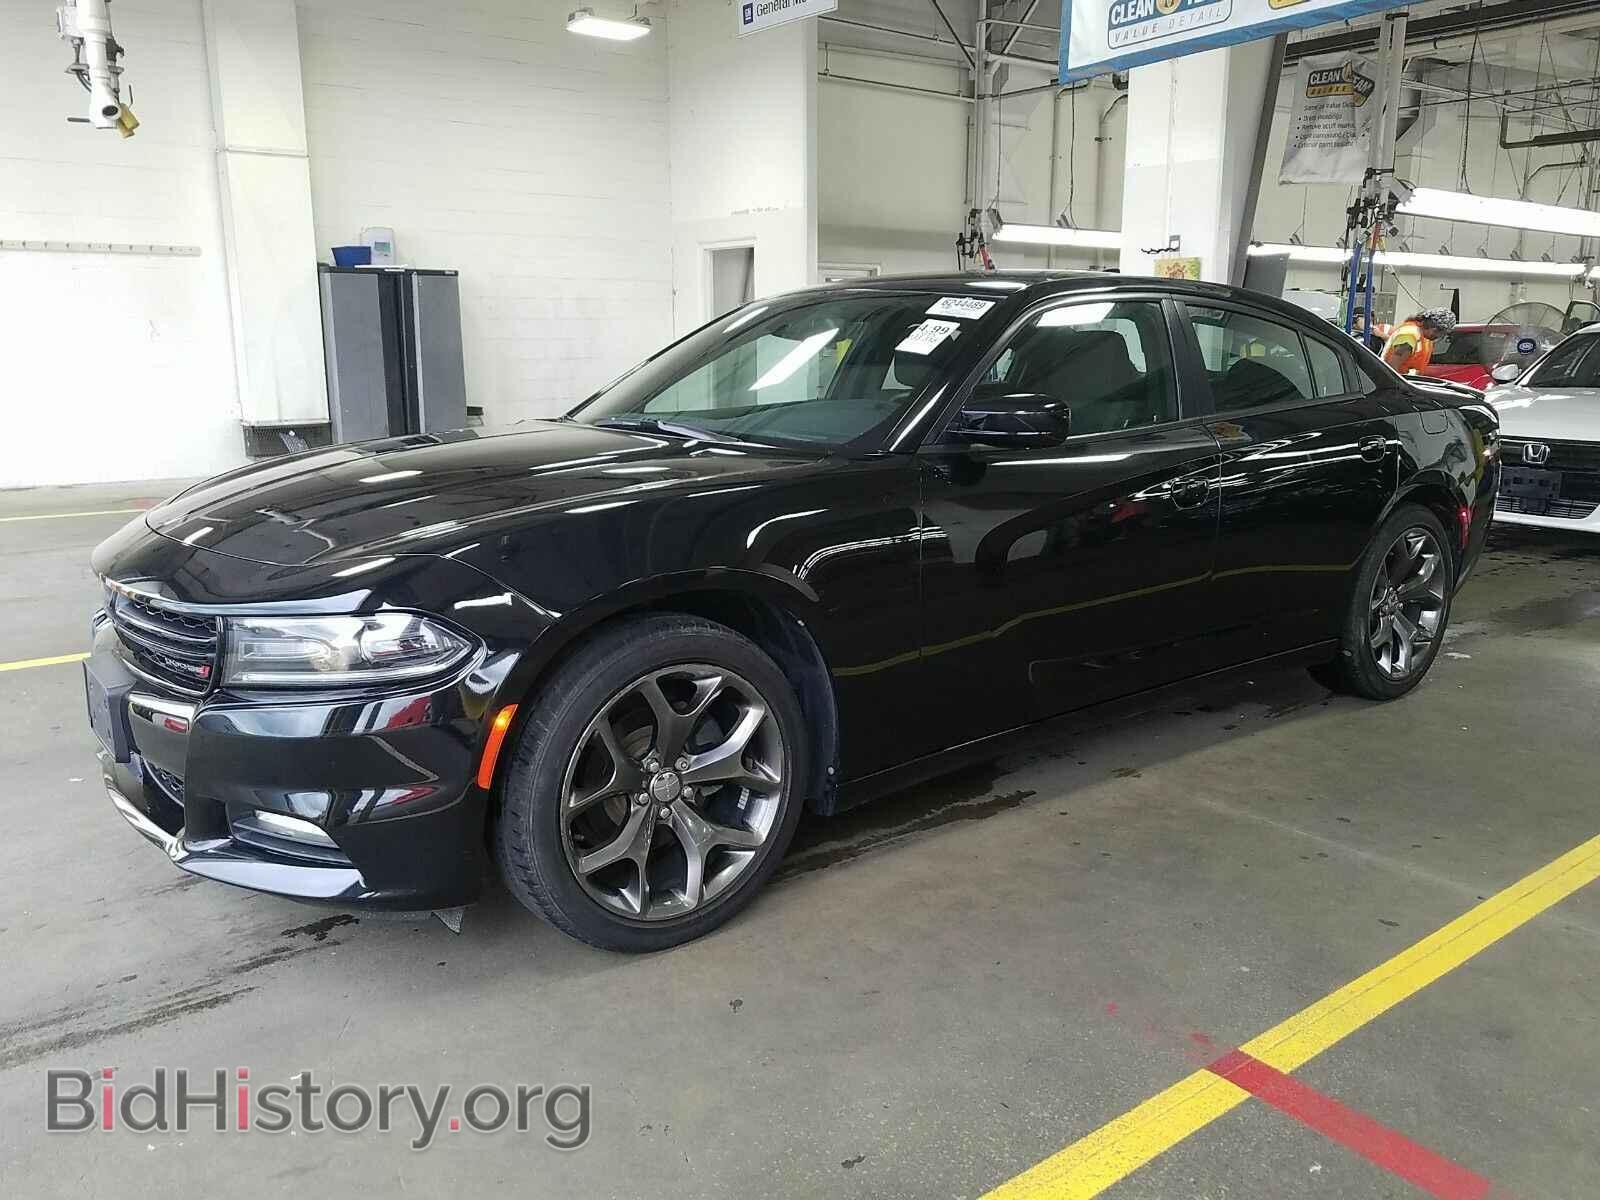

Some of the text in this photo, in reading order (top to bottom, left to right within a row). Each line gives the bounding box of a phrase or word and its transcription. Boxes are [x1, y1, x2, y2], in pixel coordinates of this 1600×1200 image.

[1111, 0, 1155, 25] CLEAN
[1114, 10, 1223, 42] VALUE DETAIL
[1310, 70, 1341, 85] CLEAN
